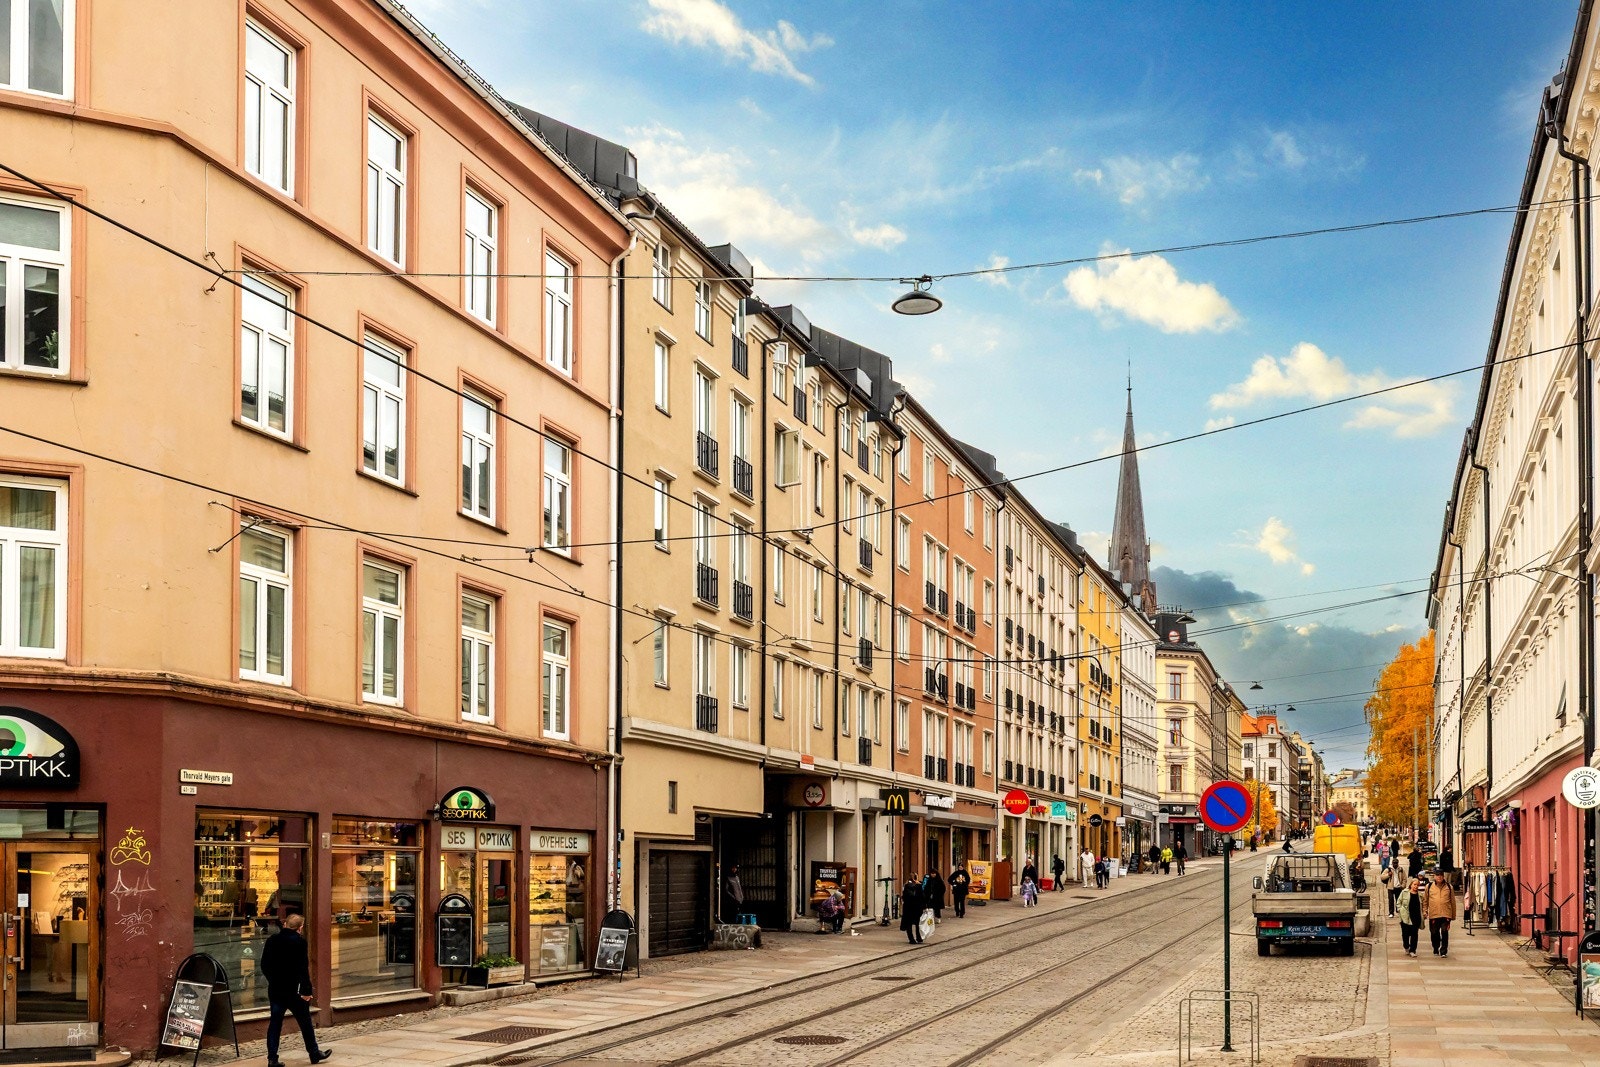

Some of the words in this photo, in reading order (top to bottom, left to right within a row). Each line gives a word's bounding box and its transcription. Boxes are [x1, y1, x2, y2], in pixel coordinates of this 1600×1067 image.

[183, 770, 203, 780] Thorvald
[204, 772, 220, 782] Meyers
[221, 775, 231, 784] gate
[1571, 770, 1598, 781] CULTIVATE
[447, 831, 466, 845] SES
[479, 832, 511, 847] OPTIKK
[539, 835, 578, 849] ØYEHELSE
